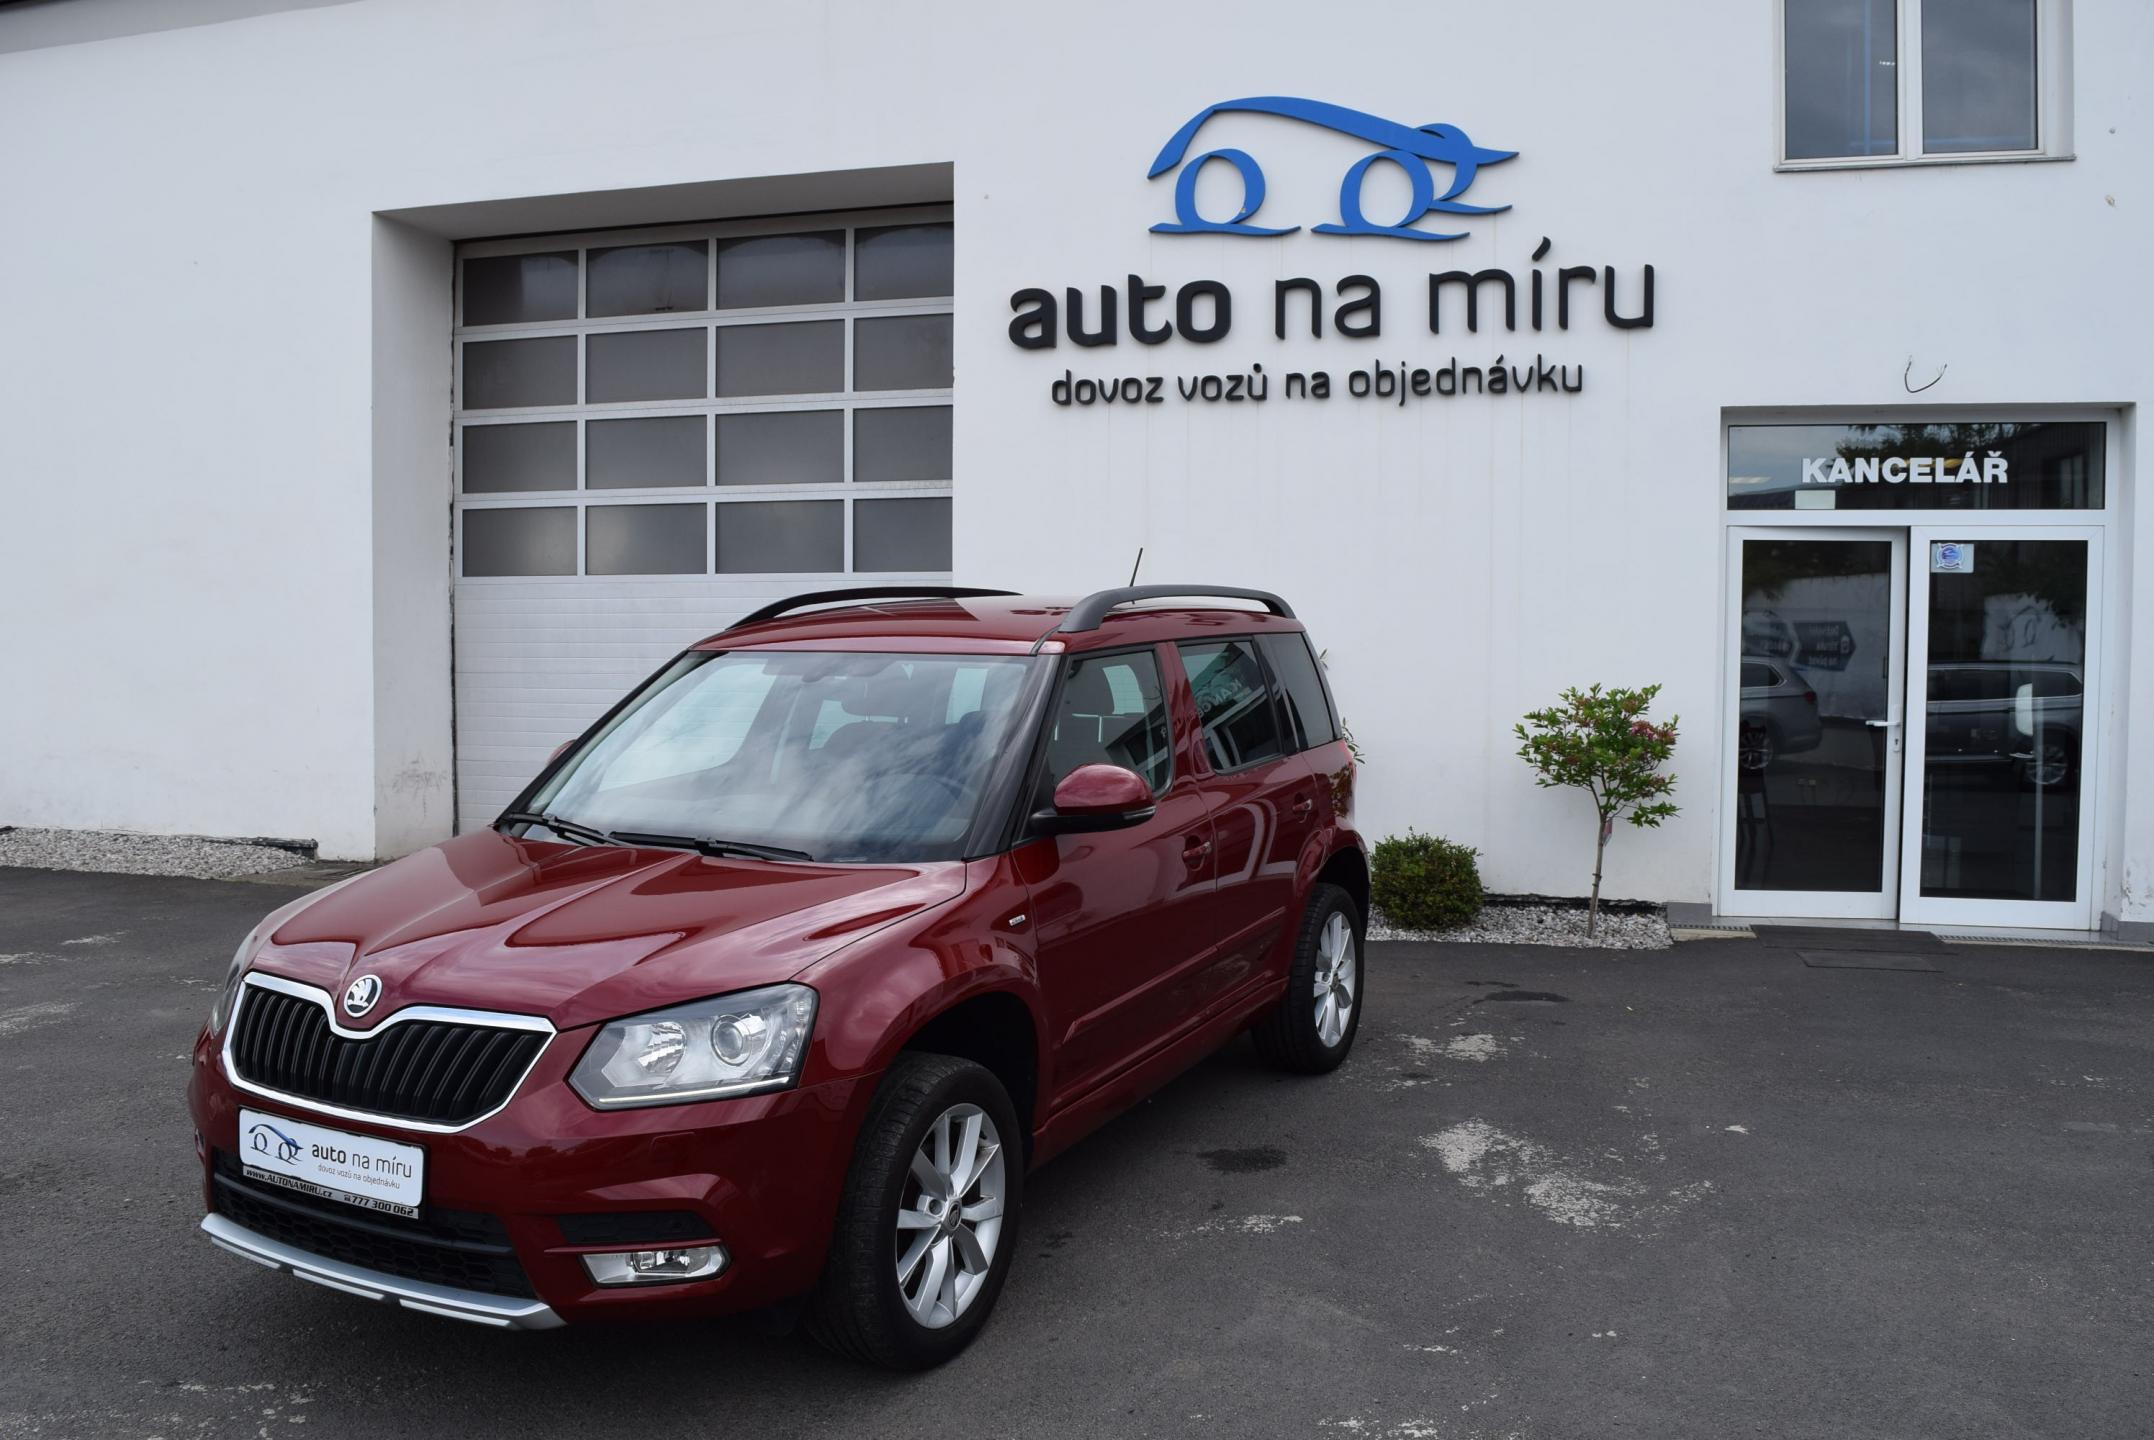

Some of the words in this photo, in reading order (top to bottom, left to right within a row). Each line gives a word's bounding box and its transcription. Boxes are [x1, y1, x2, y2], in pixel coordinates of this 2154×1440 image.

[1008, 274, 1232, 350] auto
[1275, 274, 1381, 340] na
[1429, 236, 1654, 334] míru
[1051, 369, 1164, 406] dovoz
[1177, 363, 1267, 401] vozů
[1285, 371, 1330, 399] na
[1349, 353, 1583, 407] objednávku
[1802, 451, 2008, 484] KANCELÁŘ
[311, 1143, 347, 1164] auto
[352, 1153, 370, 1169] na
[376, 1155, 412, 1178] míru
[318, 1164, 336, 1175] dovoz
[362, 1174, 401, 1189] objednávku
[352, 1195, 370, 1206] 777
[372, 1200, 391, 1212] 300
[393, 1205, 414, 1217] 062
